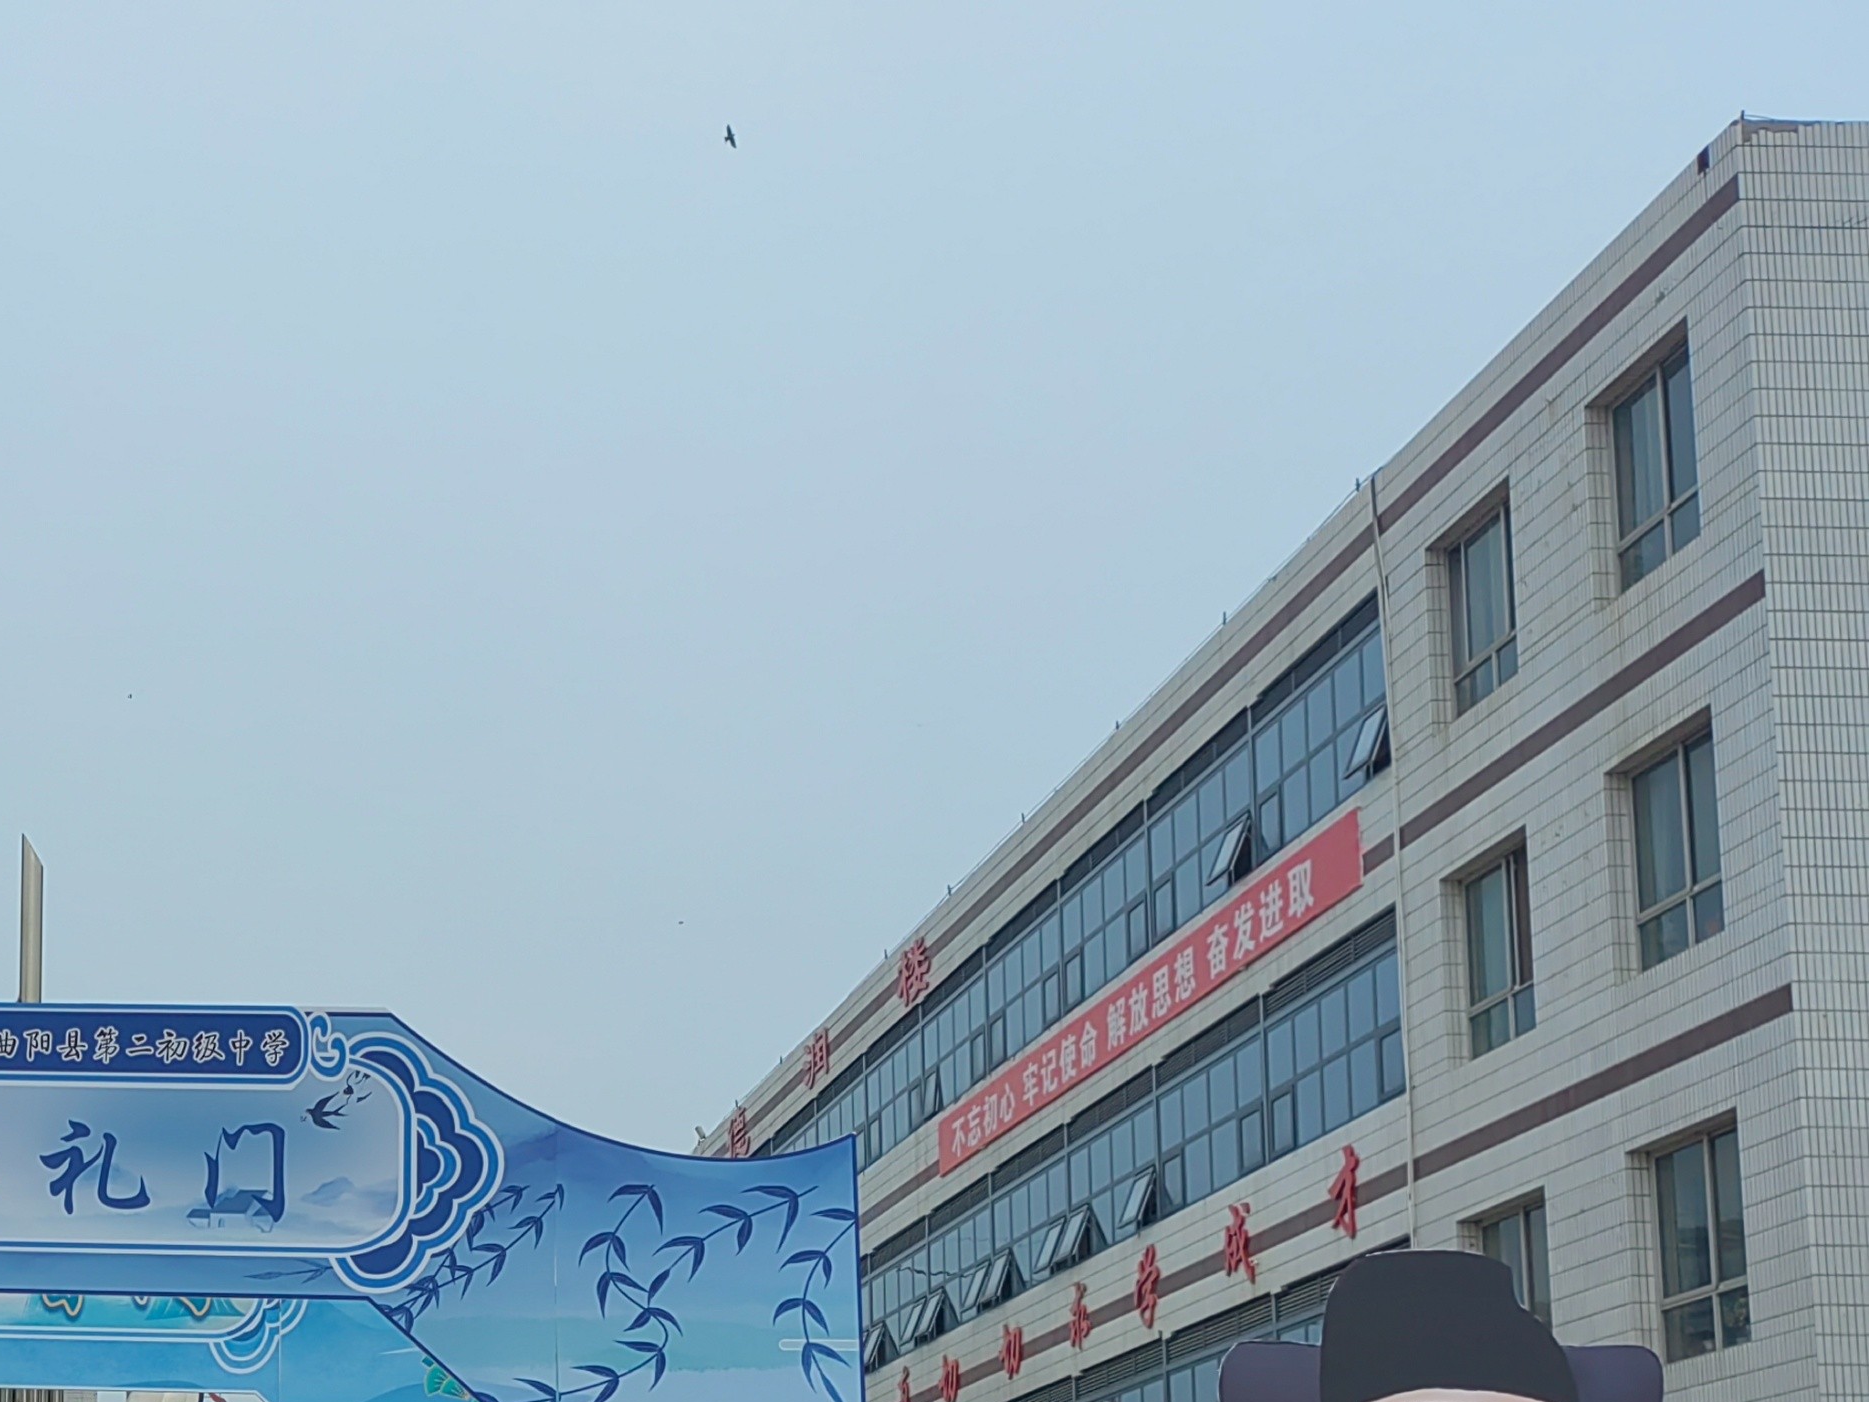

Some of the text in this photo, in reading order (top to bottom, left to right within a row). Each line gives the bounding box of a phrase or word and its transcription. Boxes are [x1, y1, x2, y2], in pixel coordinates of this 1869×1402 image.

[951, 858, 1316, 1158] 不忘初心 牢记使命 解放思想 奋发进取
